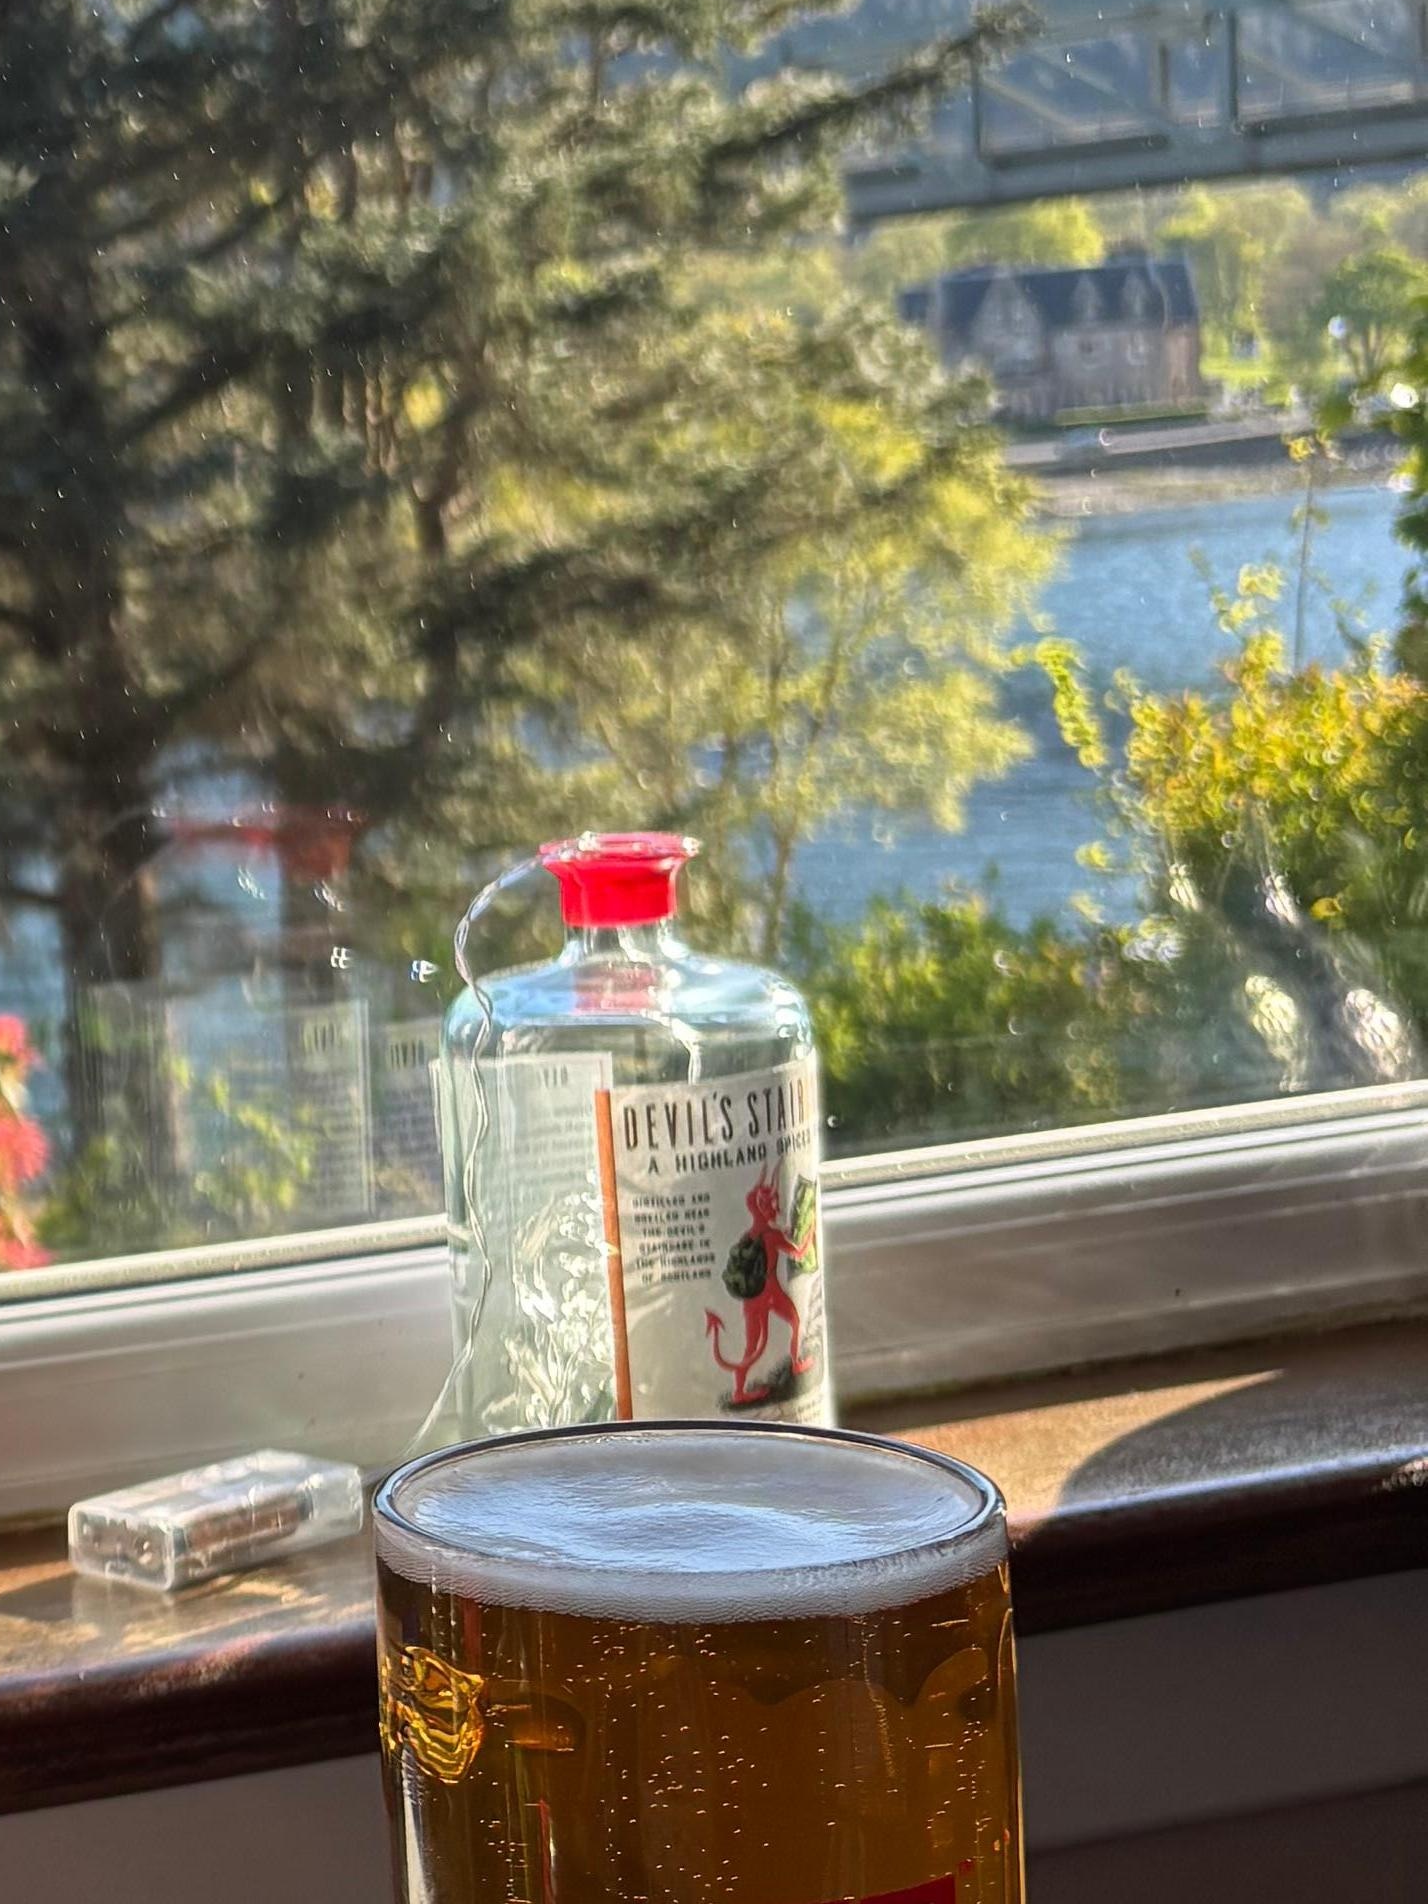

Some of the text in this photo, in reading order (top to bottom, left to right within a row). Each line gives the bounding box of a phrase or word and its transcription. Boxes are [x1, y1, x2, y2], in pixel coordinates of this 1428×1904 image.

[623, 1090, 734, 1151] DEVIL'S
[647, 1156, 660, 1175] A
[675, 1142, 767, 1174] HIGHLAND
